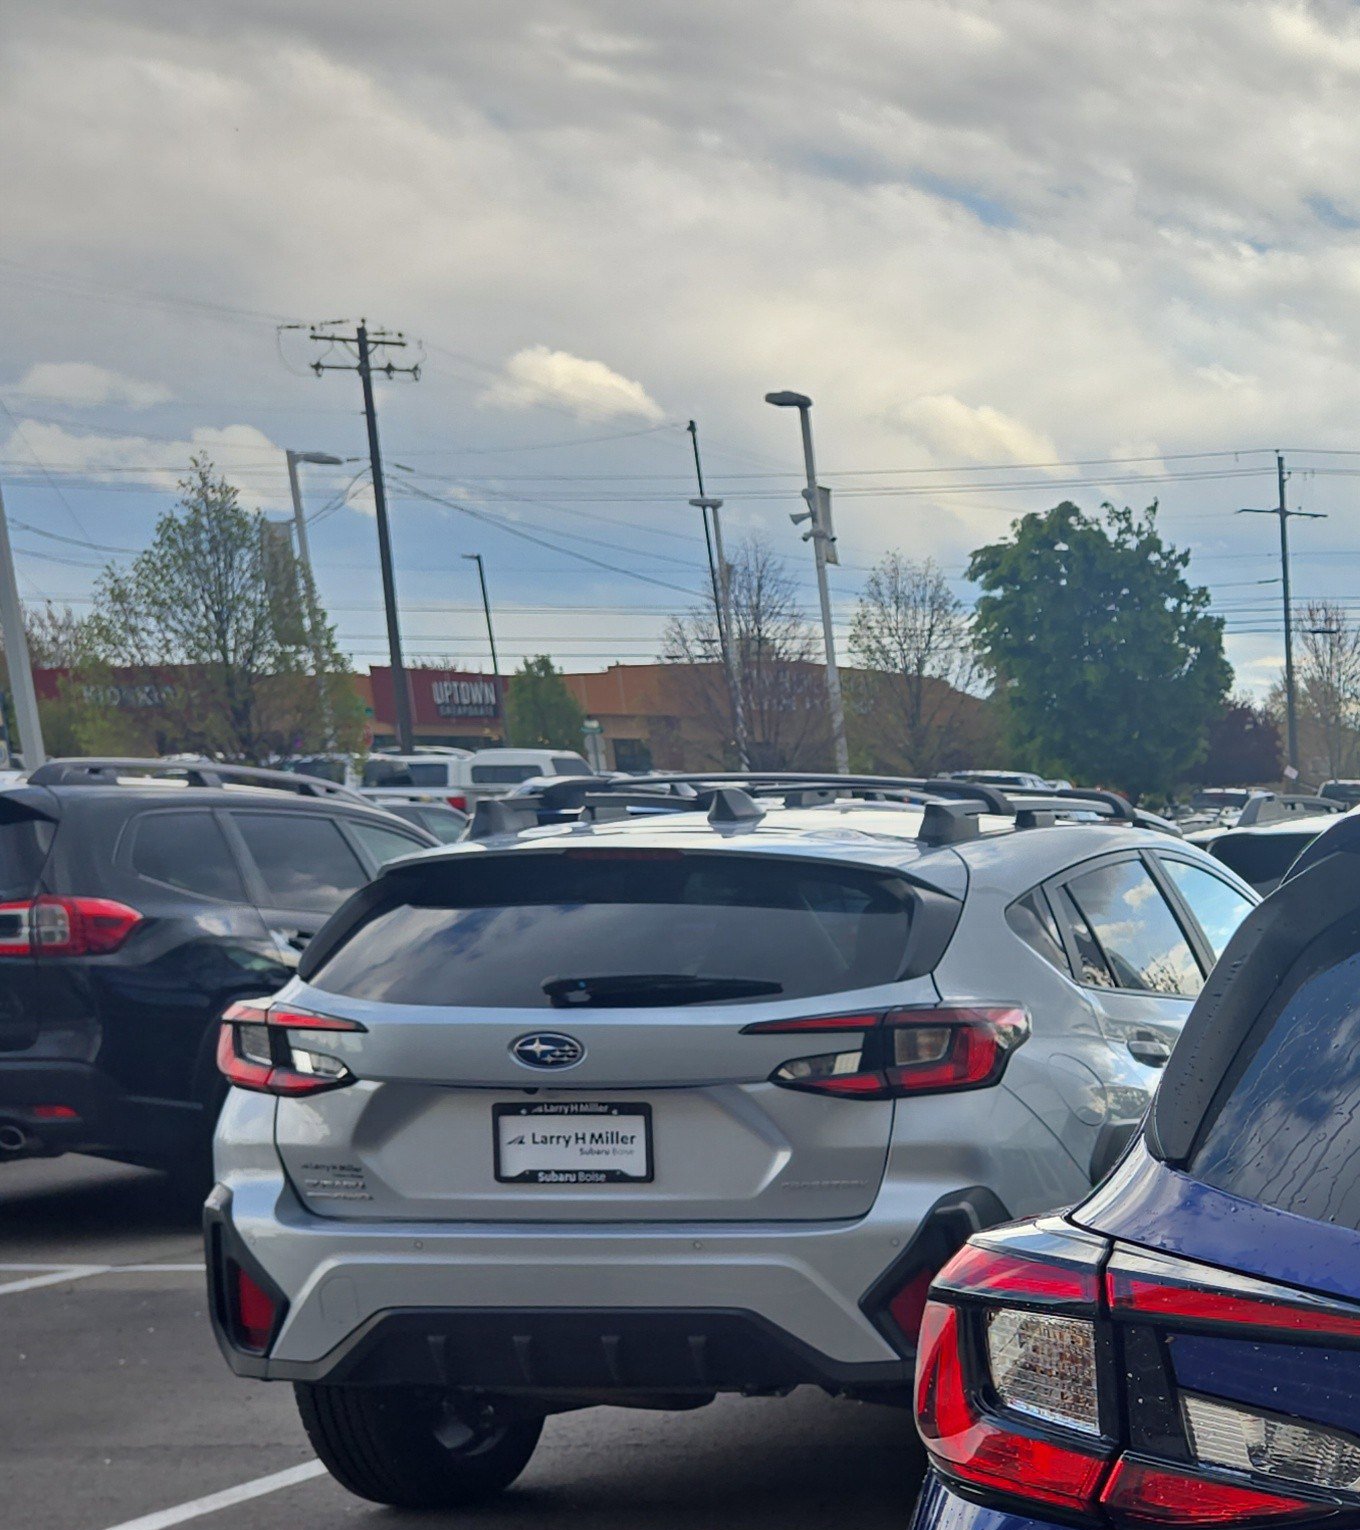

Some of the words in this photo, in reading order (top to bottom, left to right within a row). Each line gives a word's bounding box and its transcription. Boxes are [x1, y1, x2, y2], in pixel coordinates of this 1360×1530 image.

[433, 680, 496, 705] UPTOWN
[544, 1103, 570, 1114] Larry
[571, 1104, 578, 1112] H
[579, 1103, 608, 1113] Miller
[531, 1132, 571, 1148] Larry
[575, 1132, 586, 1145] H
[589, 1131, 636, 1145] Miller
[538, 1171, 576, 1182] Subaru
[578, 1171, 607, 1182] Boise
